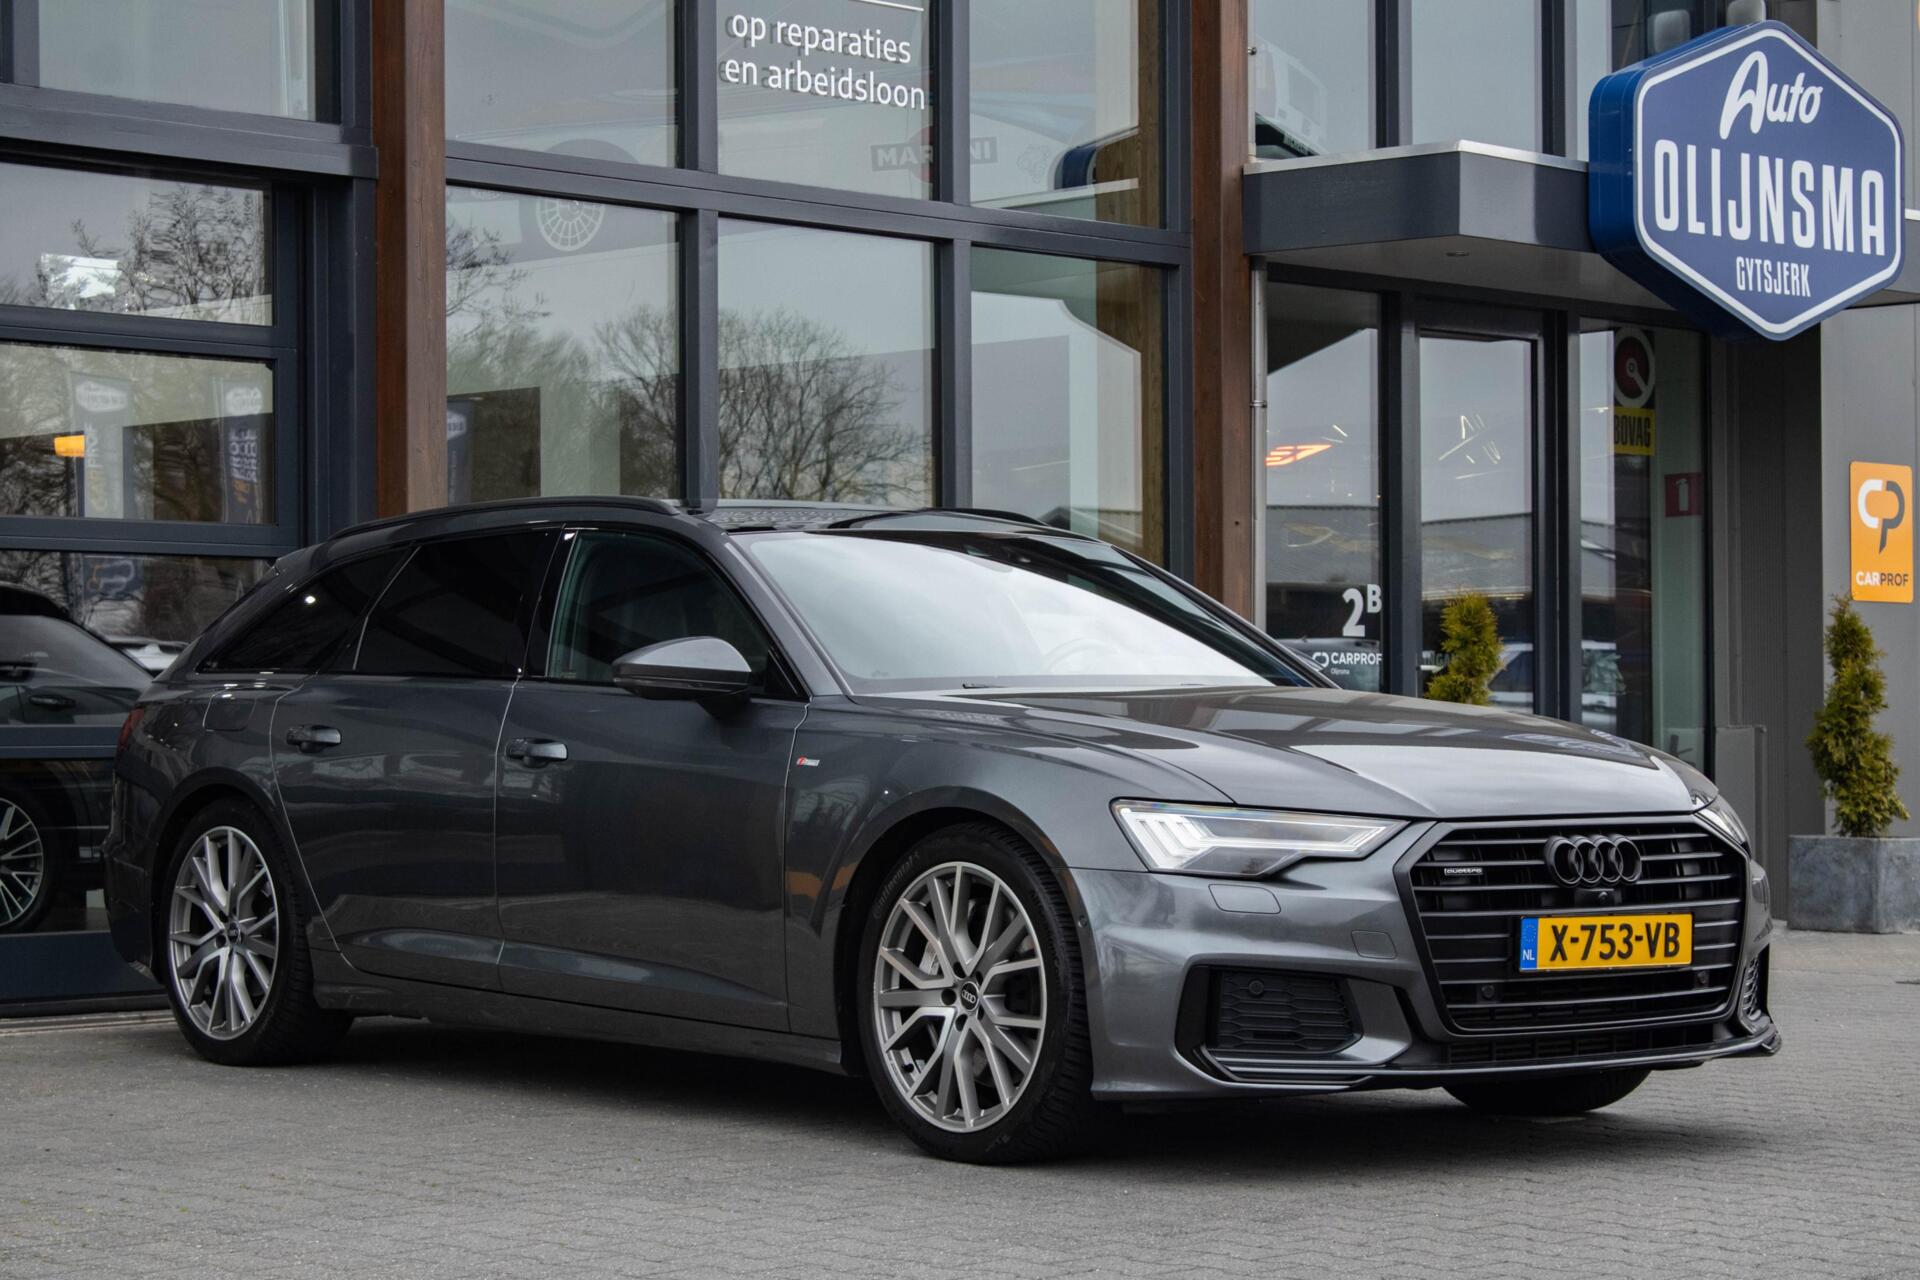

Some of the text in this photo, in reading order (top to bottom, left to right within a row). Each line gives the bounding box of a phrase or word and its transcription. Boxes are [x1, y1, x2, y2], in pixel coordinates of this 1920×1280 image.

[732, 14, 911, 63] op reparaties
[725, 59, 925, 110] en arbeidsloon
[1719, 51, 1823, 139] Auto
[1654, 139, 1885, 256] OLIJNSMA
[1736, 256, 1811, 297] GYTSJERK
[1855, 571, 1909, 587] CARPROF
[1331, 652, 1383, 665] CARPROF
[1523, 949, 1535, 961] NL
[1550, 922, 1680, 961] X-753-VB
